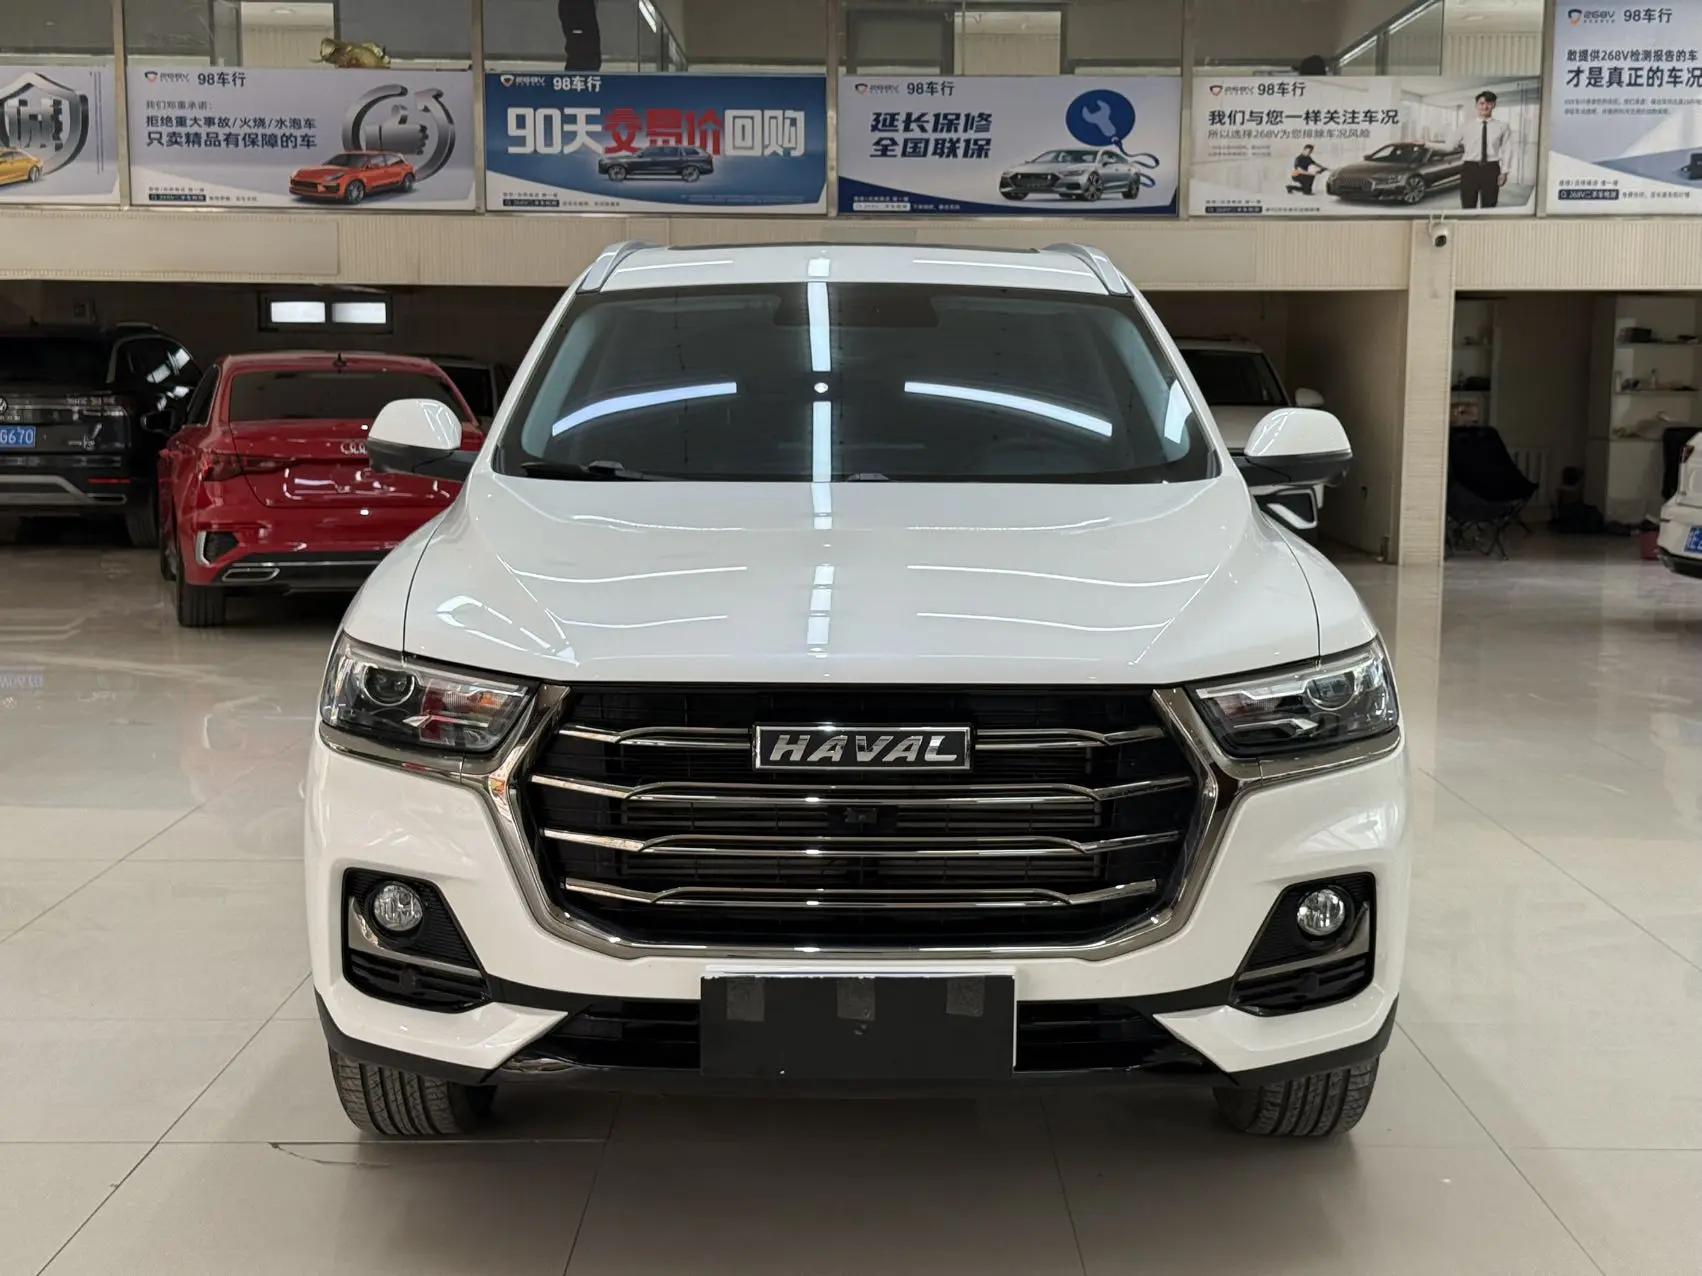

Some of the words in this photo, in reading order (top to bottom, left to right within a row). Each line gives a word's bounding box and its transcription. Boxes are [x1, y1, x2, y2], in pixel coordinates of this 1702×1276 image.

[1623, 8, 1672, 24] 98车行
[1567, 49, 1699, 62] 敢提供268V检测报告的车
[198, 71, 246, 87] 98车行
[553, 75, 601, 92] 98车行
[1566, 66, 1702, 88] 才是真正的车况
[907, 81, 955, 96] 98车行
[1257, 82, 1306, 97] 98车行
[146, 115, 317, 130] 拒绝重大事故/火烧/水泡车
[870, 112, 993, 133] 延长保修
[1208, 109, 1400, 126] 我们与您一样关注车况
[146, 131, 318, 149] 只卖精品有保障的车
[507, 107, 805, 156] 90天交易价回购
[869, 137, 992, 159] 全国联保
[769, 734, 958, 762] HAVAL
